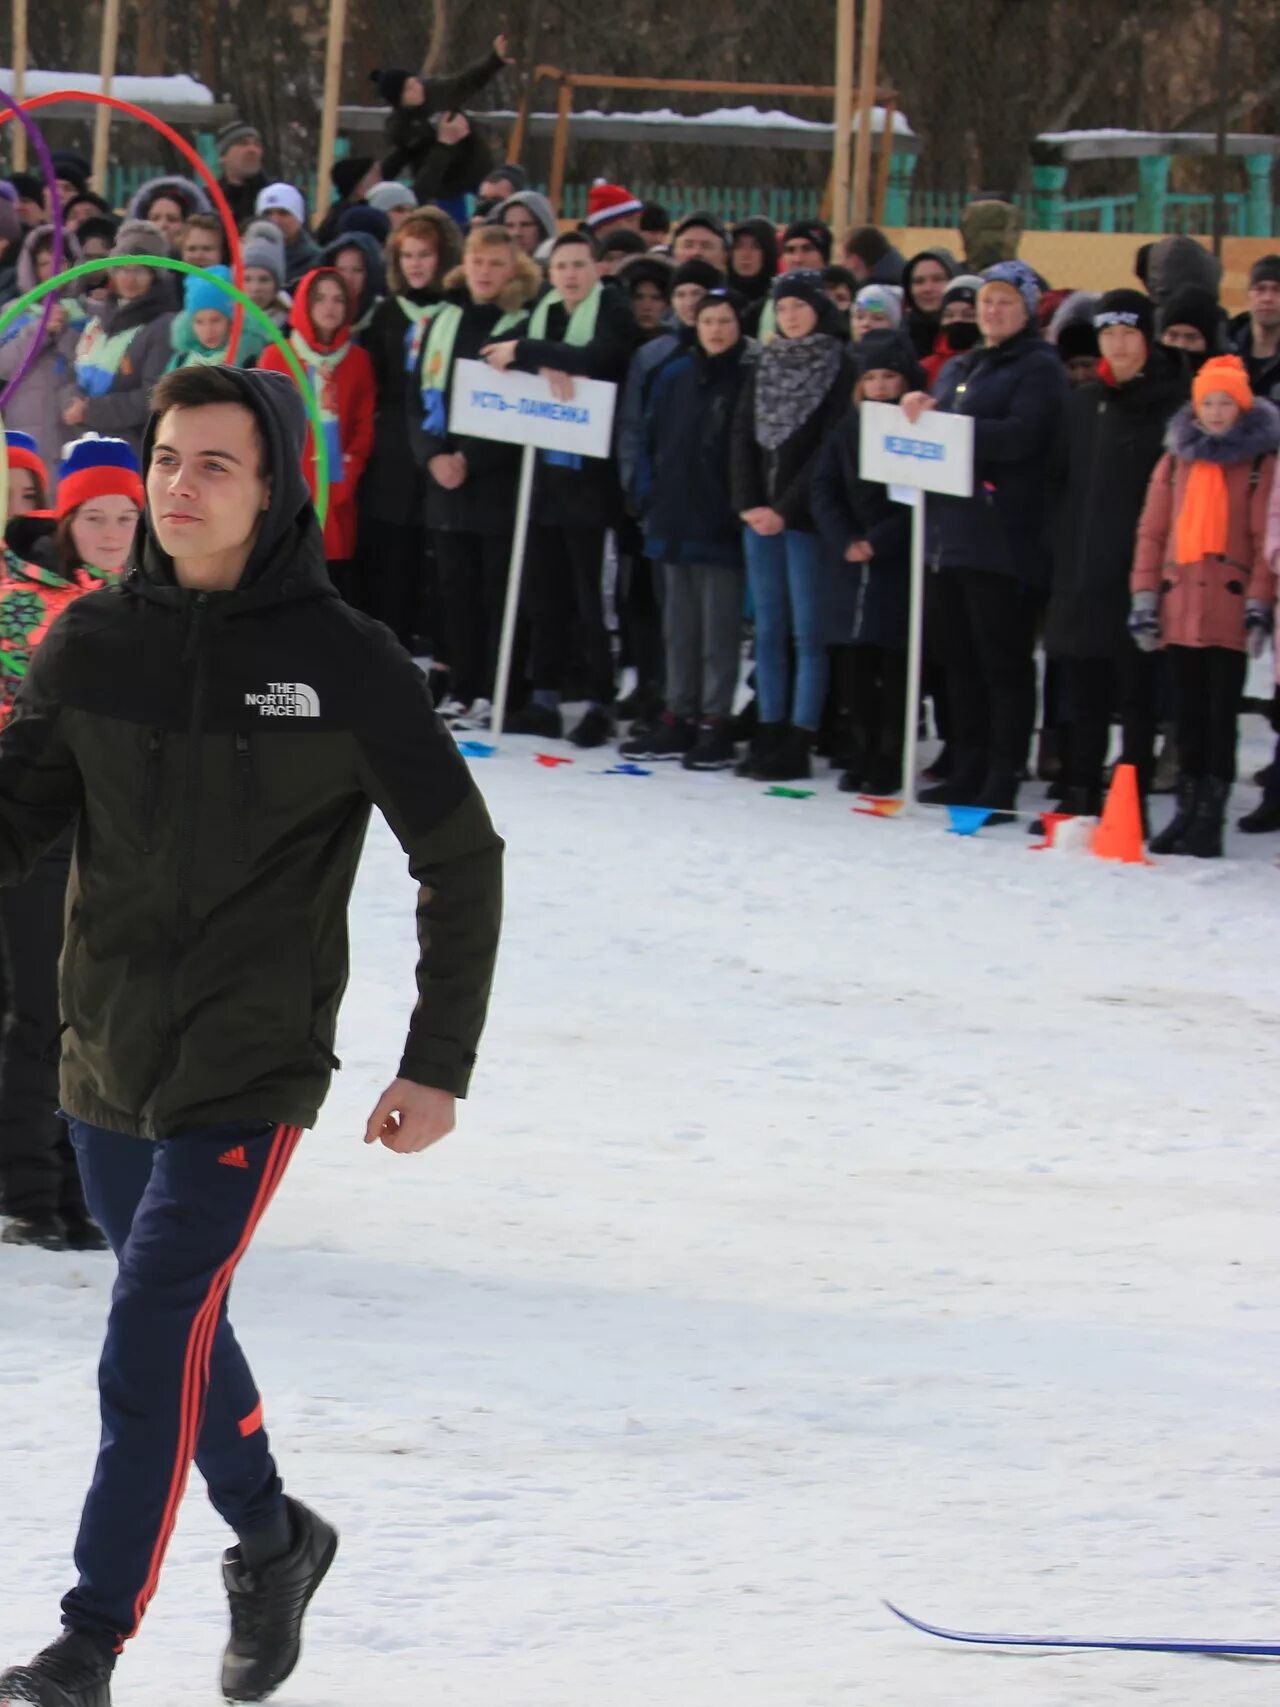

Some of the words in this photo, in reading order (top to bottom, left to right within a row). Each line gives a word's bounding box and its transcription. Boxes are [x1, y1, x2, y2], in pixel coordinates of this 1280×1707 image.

[471, 390, 590, 425] УСТЬ-ЛАМЕНКА
[267, 683, 296, 694] THE
[245, 694, 296, 705] NORTH
[260, 705, 296, 716] FACE
